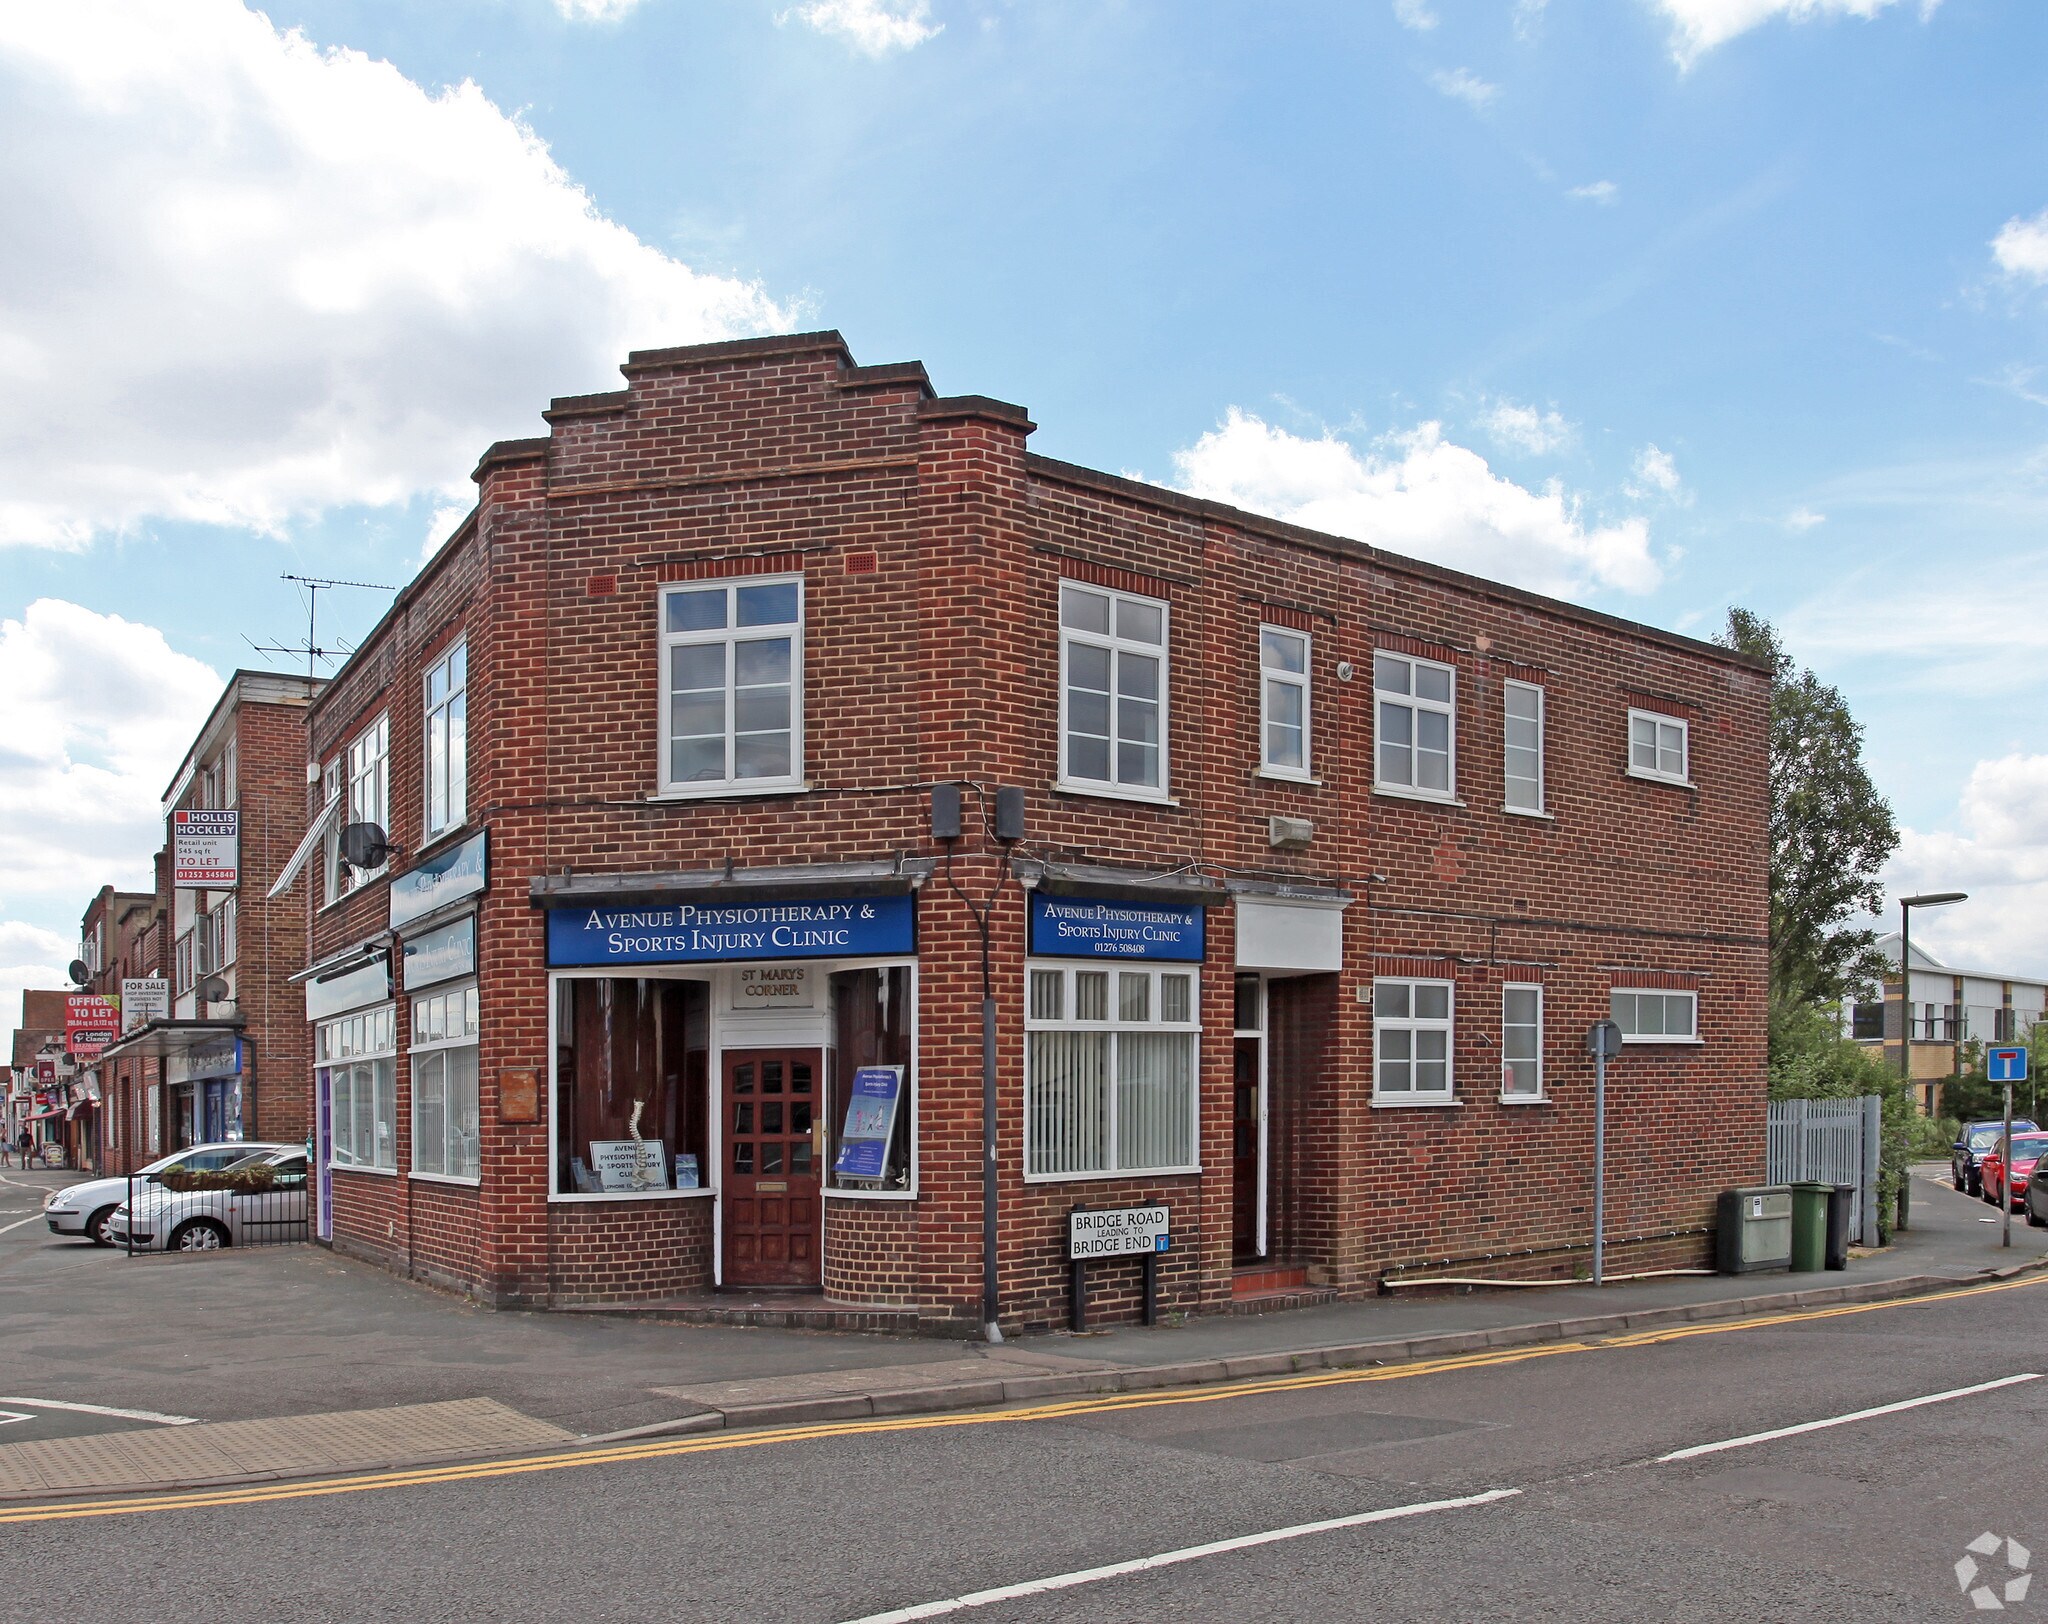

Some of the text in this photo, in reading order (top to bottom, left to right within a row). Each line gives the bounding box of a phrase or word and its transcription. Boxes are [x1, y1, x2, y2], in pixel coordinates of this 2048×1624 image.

[191, 813, 235, 822] HOLLIS
[177, 825, 234, 834] HOCKLEY
[179, 857, 219, 865] TO LET
[584, 904, 875, 930] AVENUE PHYSIOTHERAPY &
[1044, 902, 1193, 925] AVENUE PHYSIOTHERAPY &
[1058, 921, 1181, 942] SPORTS INJURY CLINIC
[608, 926, 849, 954] SPORTS INJURY CLINIC
[1094, 942, 1146, 953] 01276 508408
[741, 967, 805, 981] ST MARY'S
[125, 982, 165, 990] FOR SALE
[745, 983, 800, 997] CORNER
[68, 997, 110, 1006] OFFICE
[73, 1009, 113, 1018] TO LET
[600, 1153, 656, 1161] PHYSIOTHEPY
[1076, 1211, 1164, 1230] BRIDGE ROAD
[1097, 1226, 1144, 1238] LEADING TO
[1073, 1235, 1152, 1254] BRIDGE END
